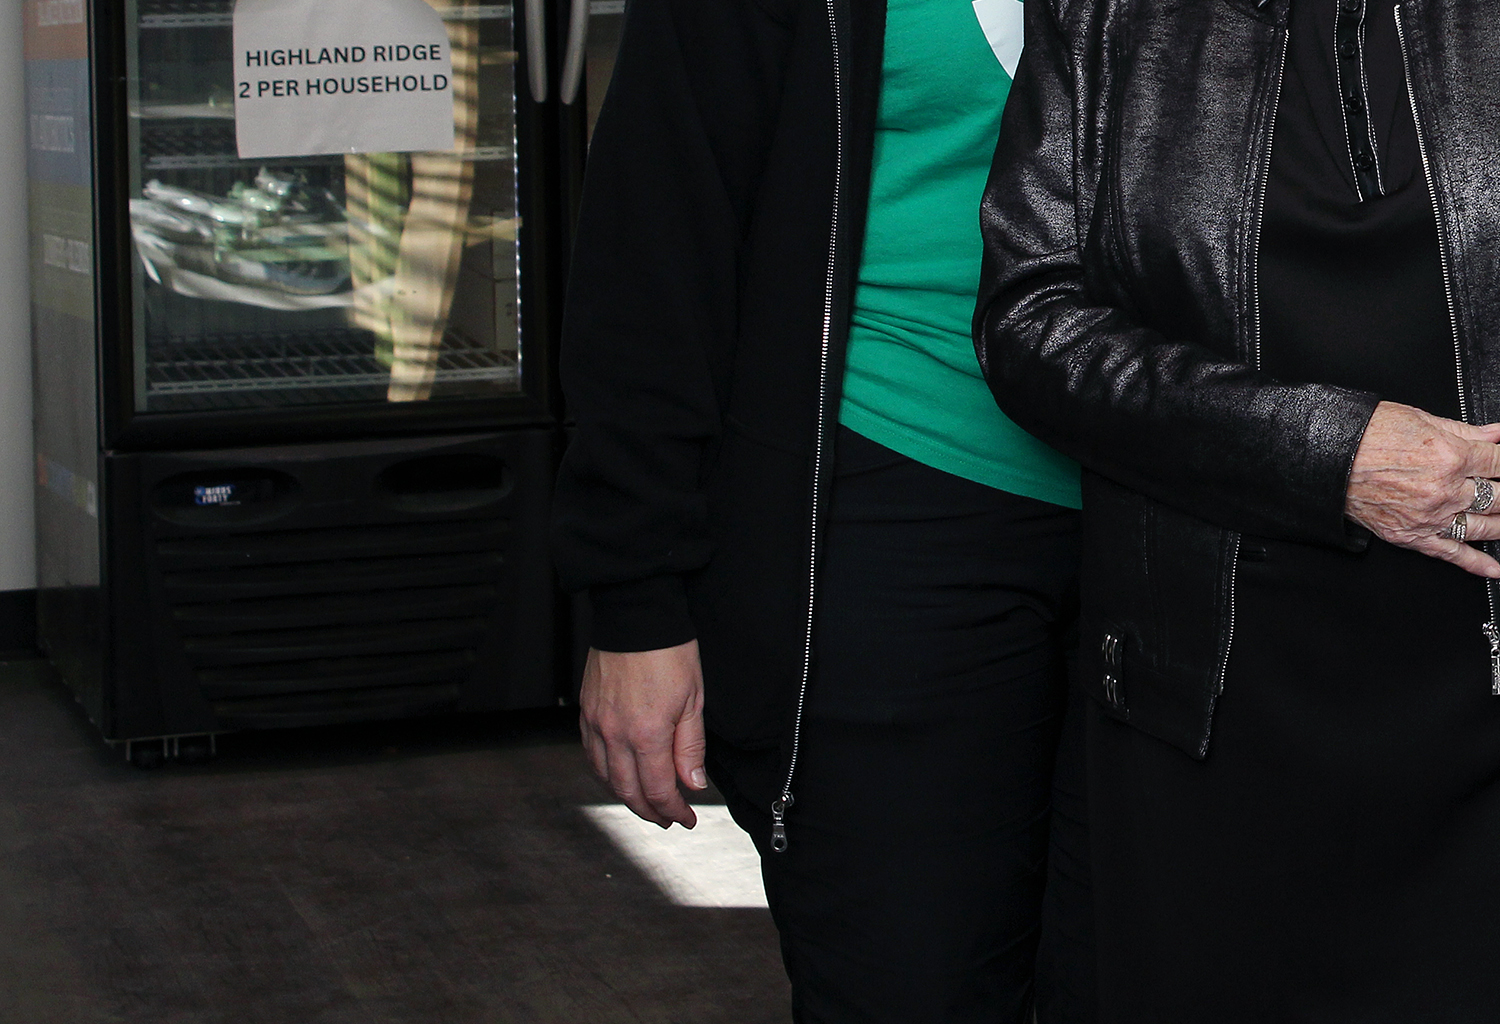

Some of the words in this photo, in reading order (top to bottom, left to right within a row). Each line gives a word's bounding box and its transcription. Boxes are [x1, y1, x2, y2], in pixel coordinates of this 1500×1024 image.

[246, 46, 366, 67] HIGHLAND
[373, 44, 442, 62] RIDGE
[239, 82, 250, 98] 2
[257, 80, 299, 97] PER
[306, 74, 448, 95] HOUSEHOLD
